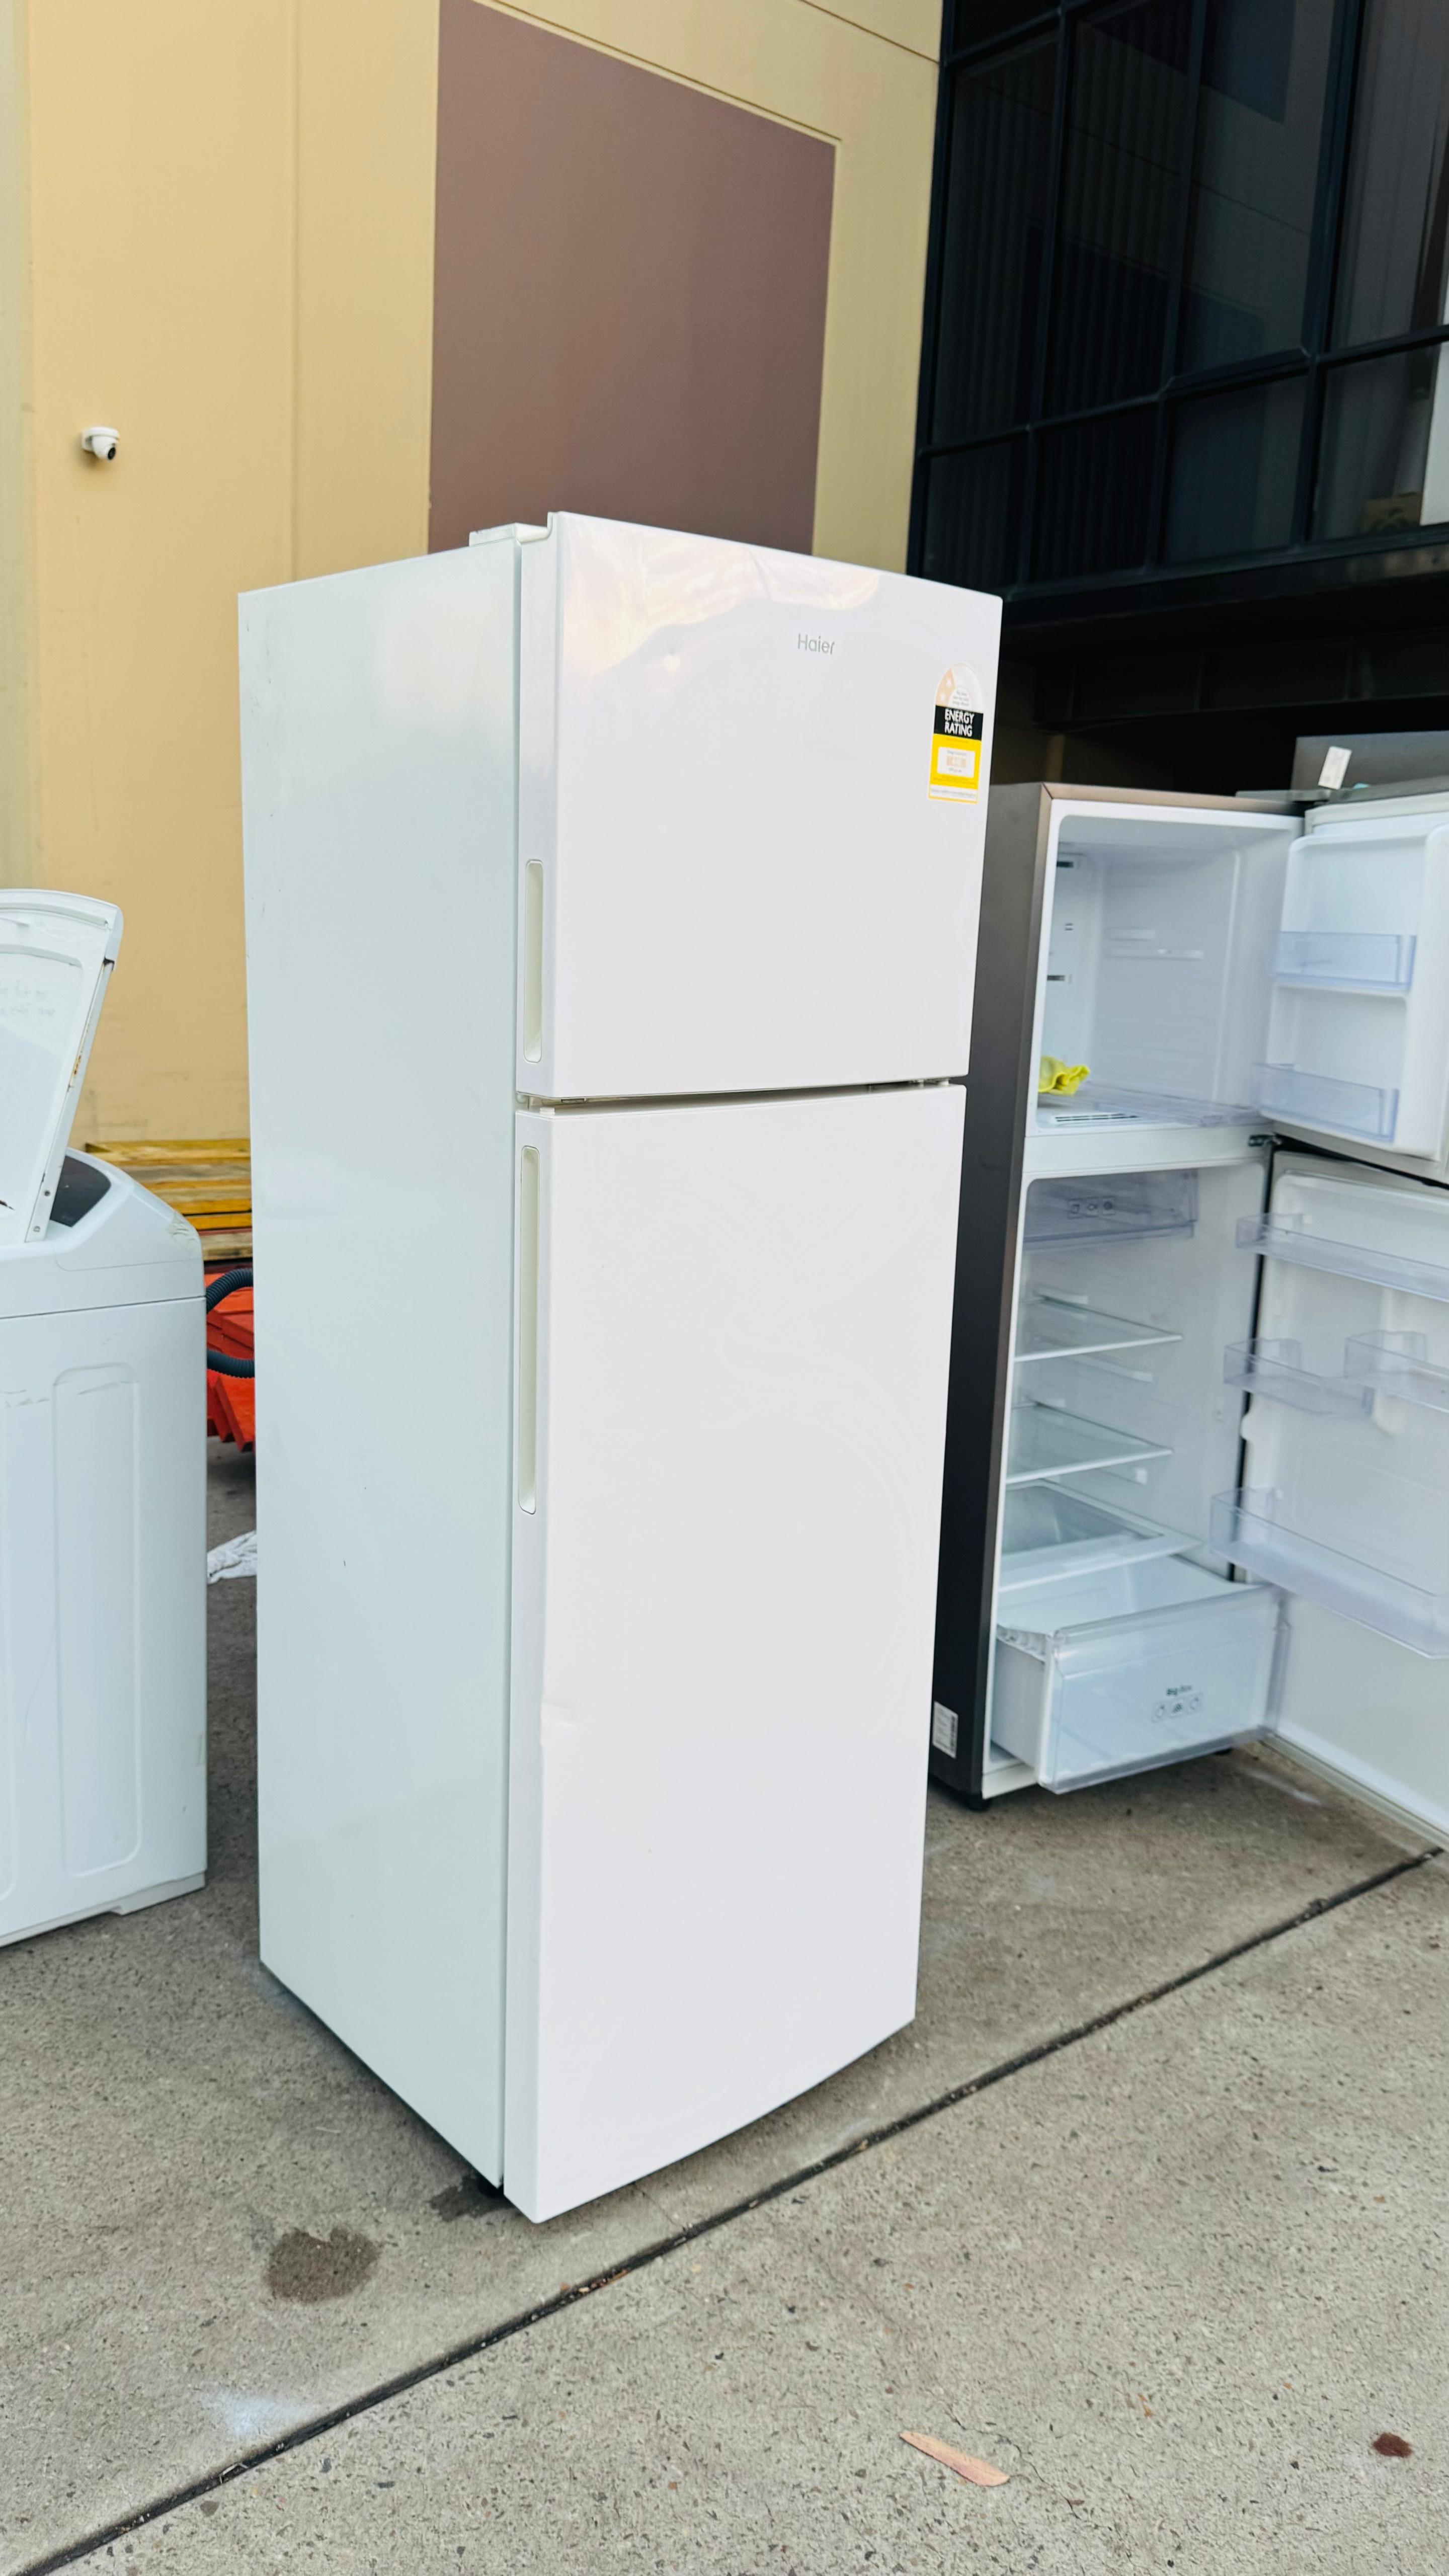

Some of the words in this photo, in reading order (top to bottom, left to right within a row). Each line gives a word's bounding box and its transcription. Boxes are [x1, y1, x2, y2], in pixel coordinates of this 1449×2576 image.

[797, 633, 835, 655] Haier
[944, 708, 975, 725] ENERGY
[944, 721, 973, 737] RATING
